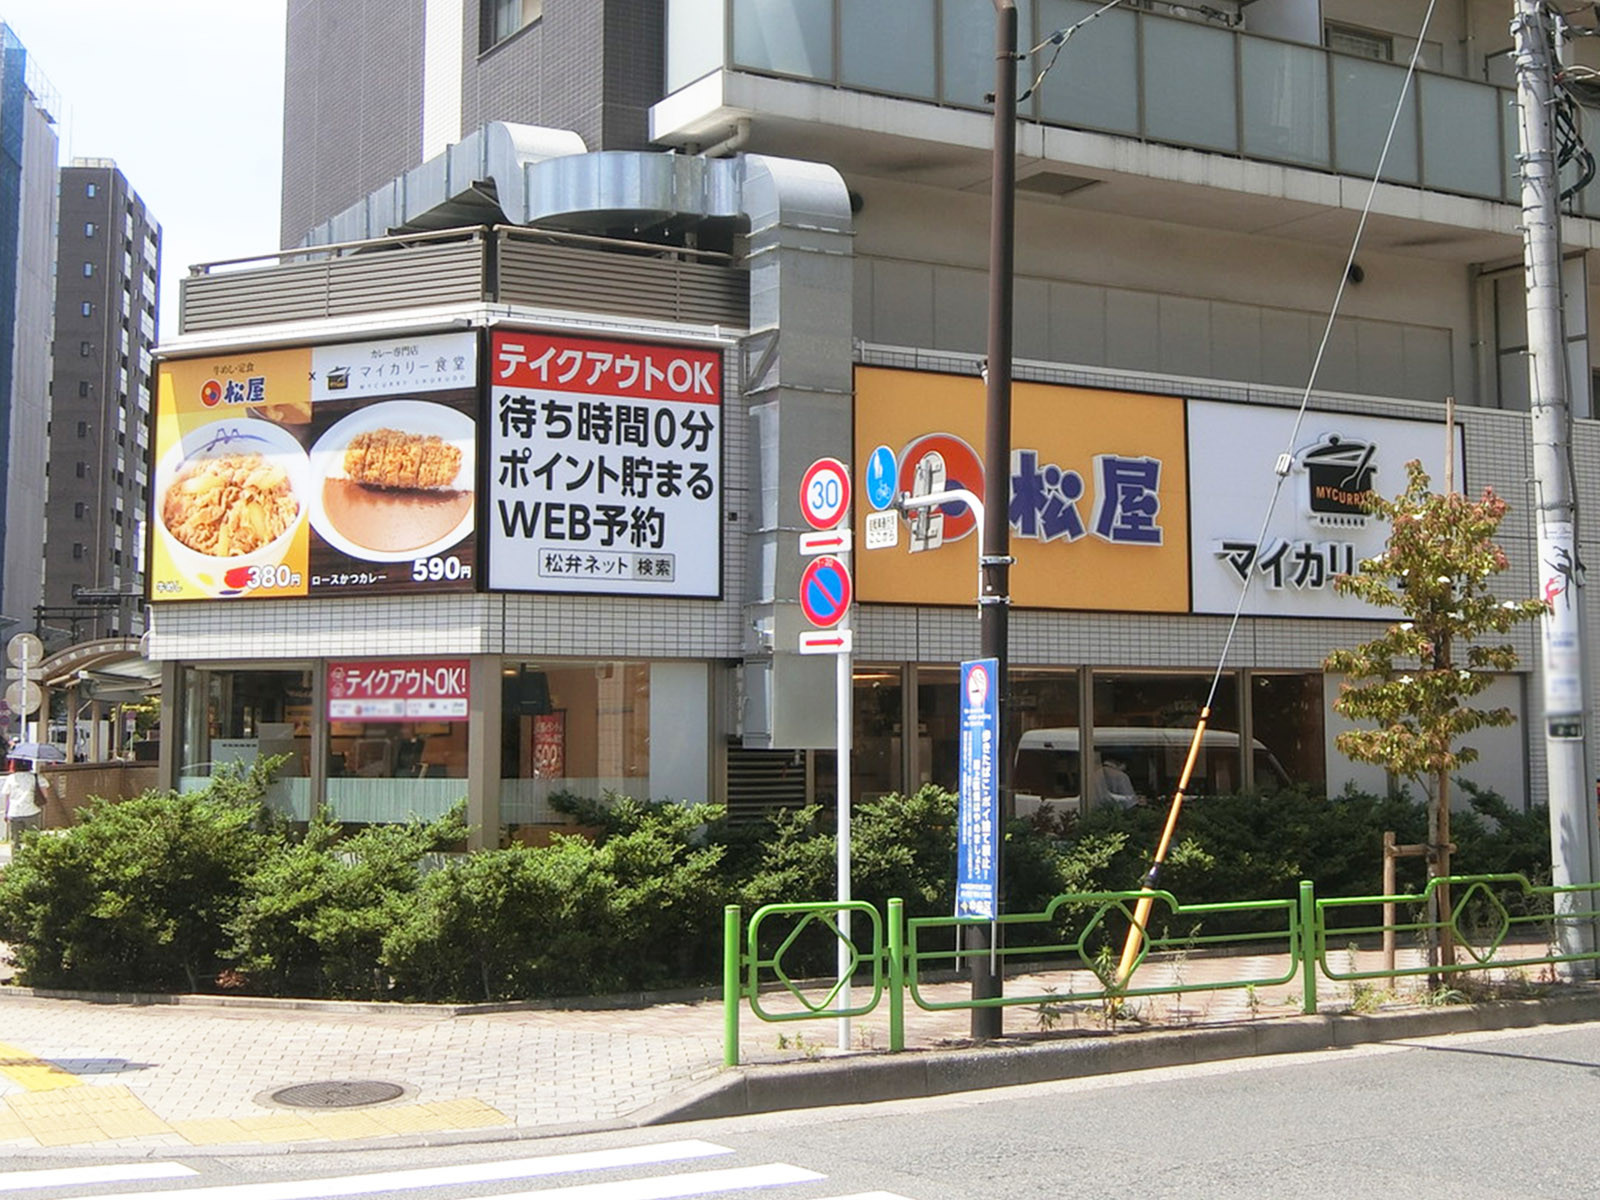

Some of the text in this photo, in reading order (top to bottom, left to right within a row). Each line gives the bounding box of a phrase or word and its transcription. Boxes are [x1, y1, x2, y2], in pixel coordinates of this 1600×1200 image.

[360, 356, 465, 377] マイカリー食堂
[498, 342, 714, 395] テイクアウトOK
[223, 376, 265, 403] 松屋
[498, 393, 714, 452] 待ち時間0分
[498, 447, 714, 501] ポイント貯まる
[812, 479, 839, 510] 30
[1009, 449, 1163, 546] 松屋
[498, 499, 665, 549] WEB予約
[246, 564, 301, 589] 380円
[412, 556, 472, 581] 590円
[545, 553, 629, 575] 松弁ネット
[636, 559, 671, 577] 検索
[156, 580, 183, 593] 牛めし
[312, 573, 387, 586] ロースかつカレー
[346, 667, 466, 695] テイクアウトOK!
